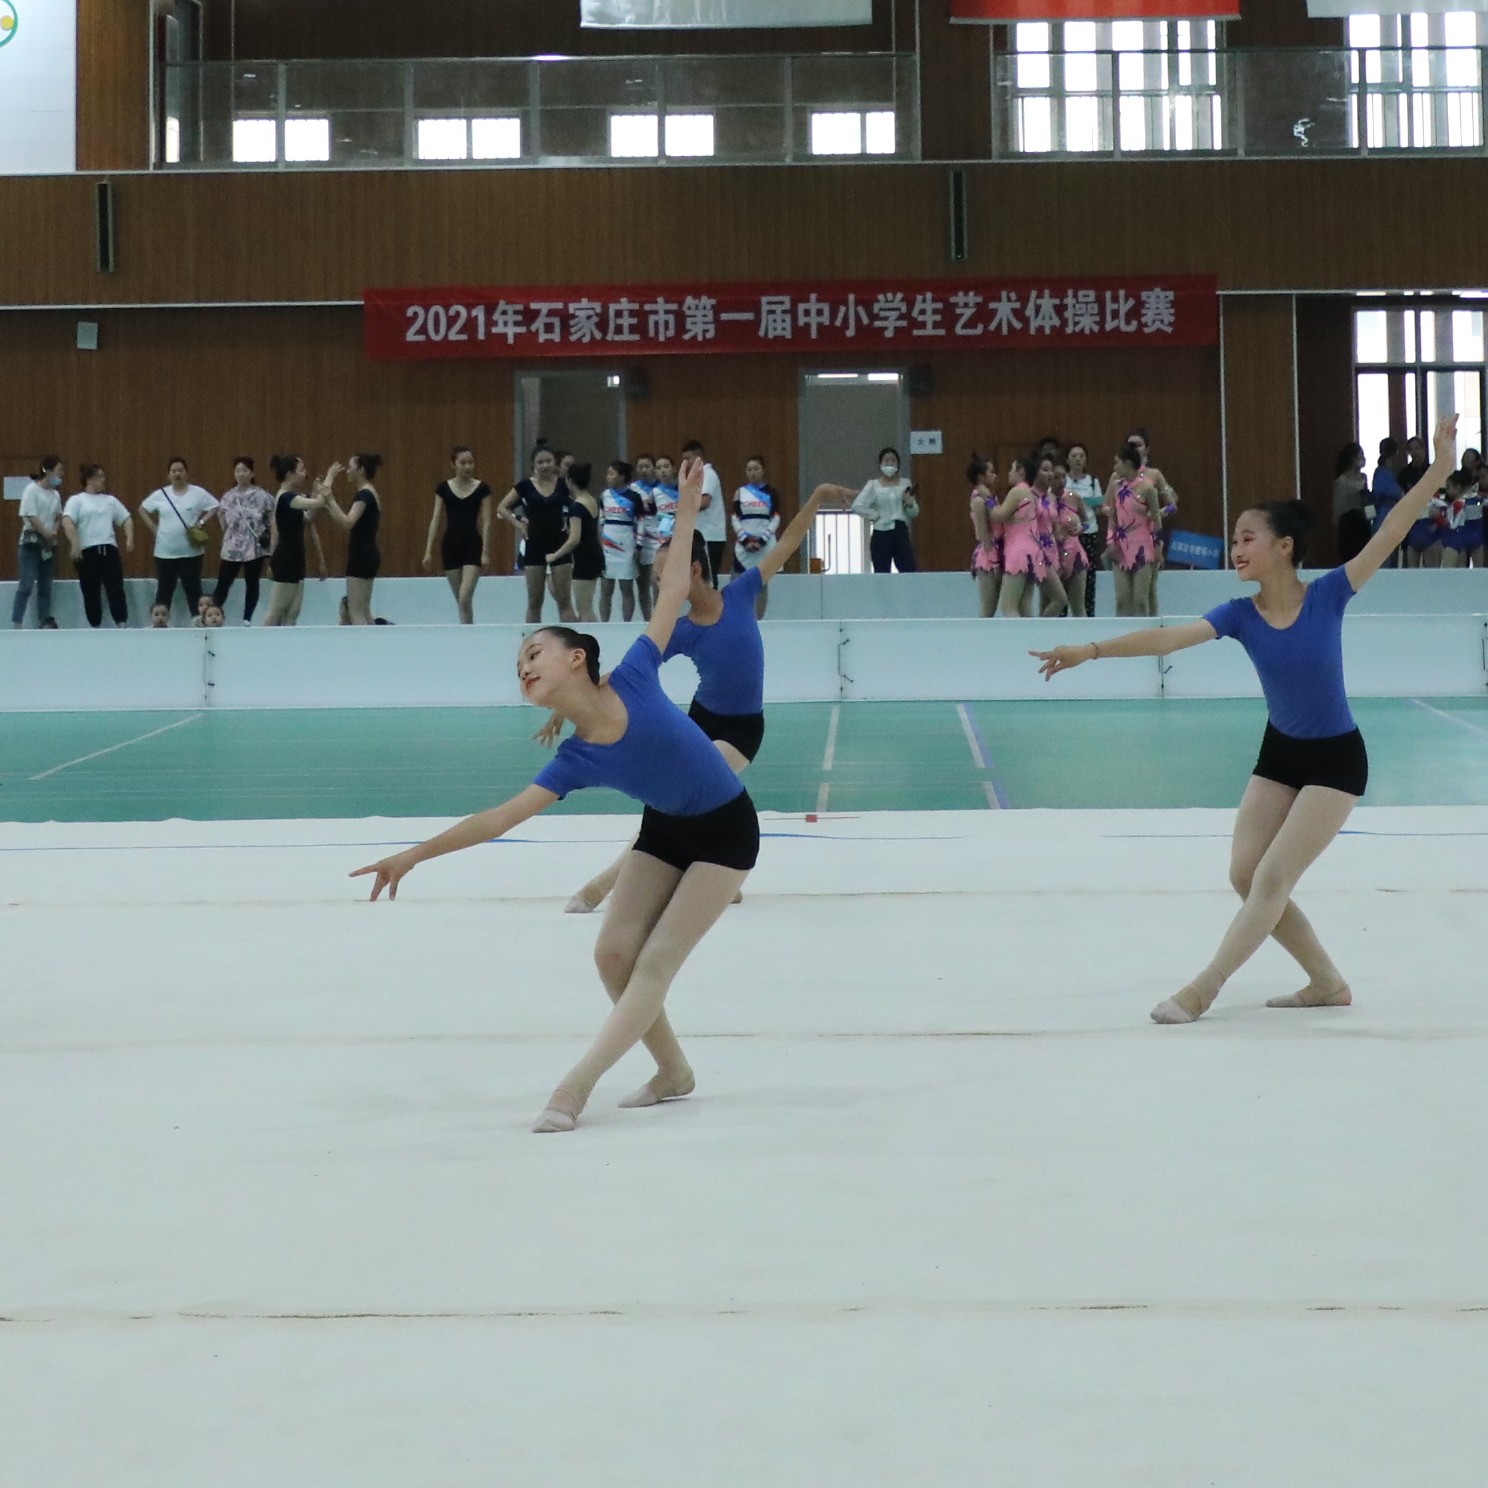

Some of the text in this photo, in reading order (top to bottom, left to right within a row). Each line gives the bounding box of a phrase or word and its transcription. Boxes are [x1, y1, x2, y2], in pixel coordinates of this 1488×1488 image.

[405, 287, 1176, 344] 2021年石家庄市第一届中小学生艺术体操比赛
